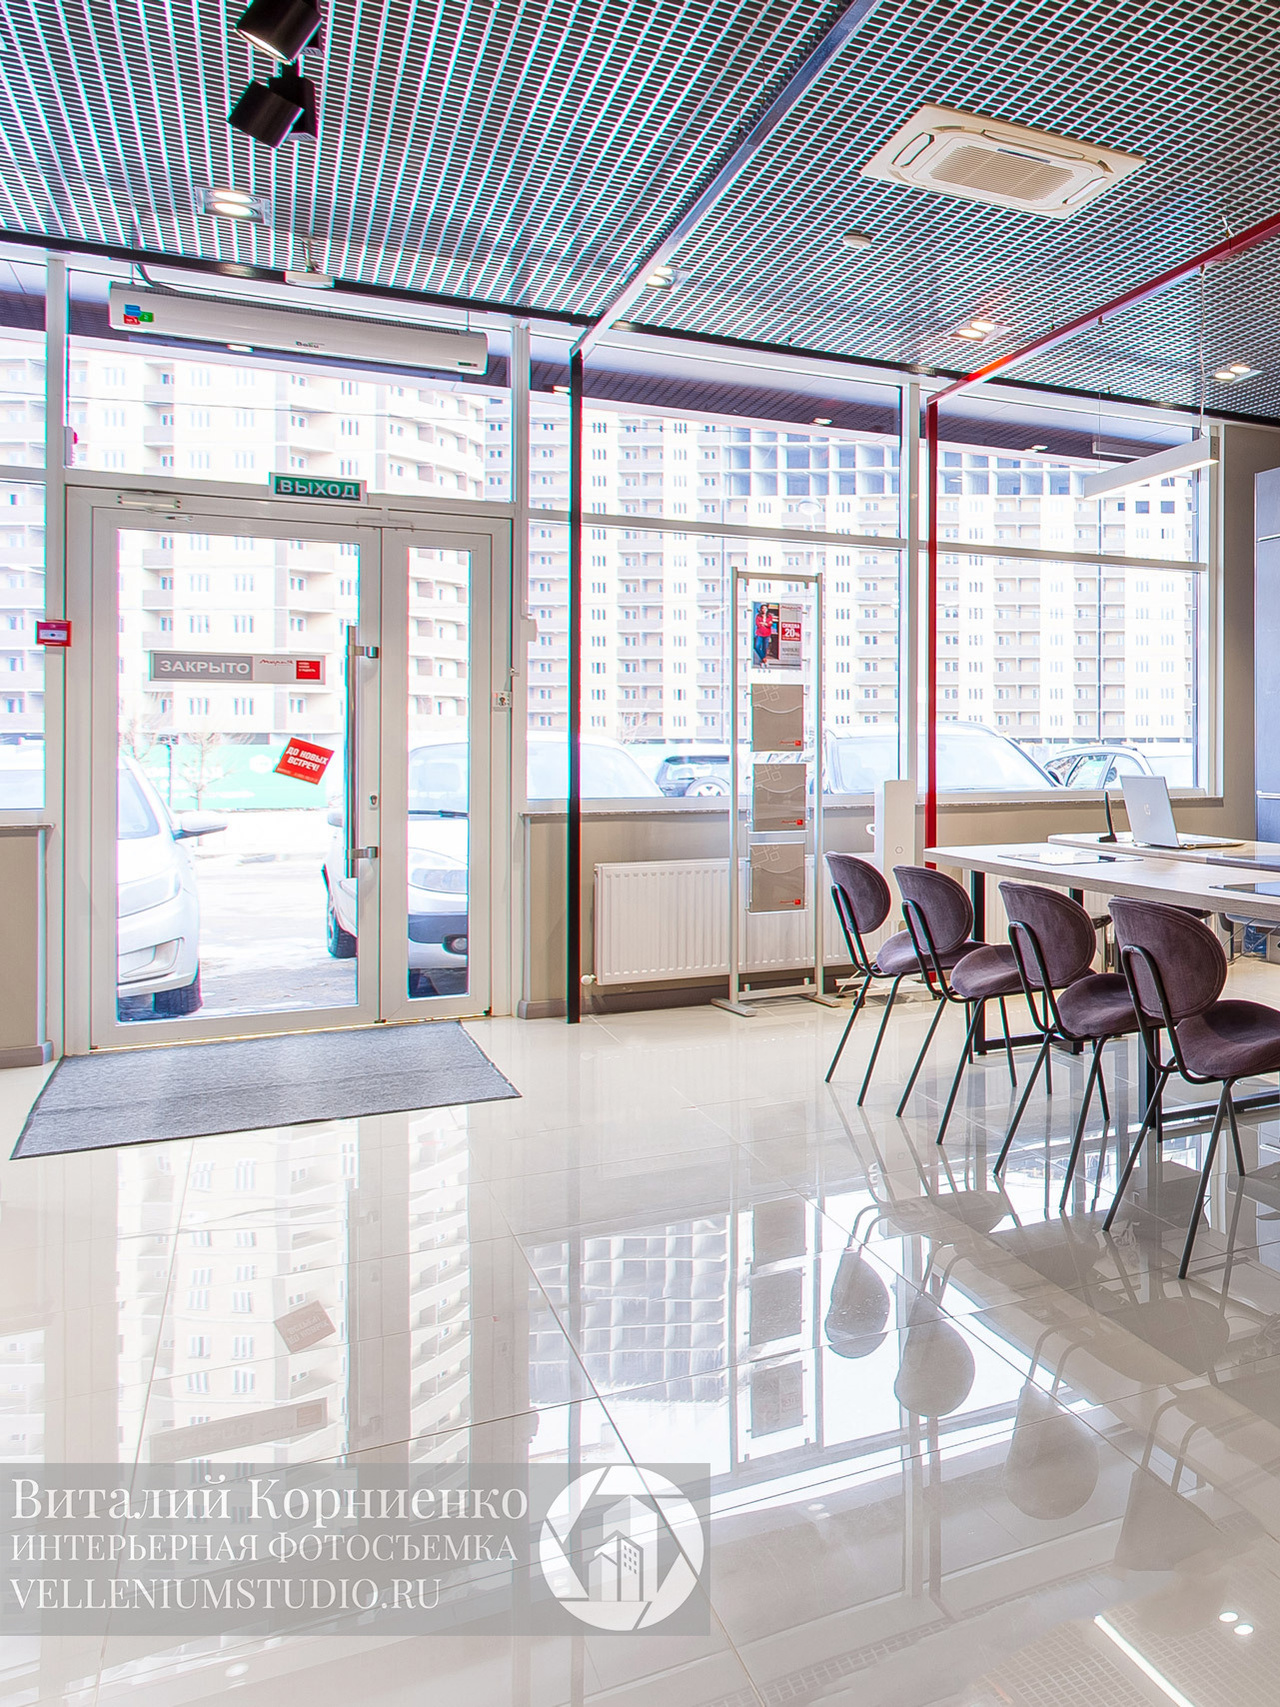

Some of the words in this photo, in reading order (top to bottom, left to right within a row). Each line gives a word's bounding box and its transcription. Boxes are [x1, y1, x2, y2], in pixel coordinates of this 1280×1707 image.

[280, 479, 360, 499] ВЫХОД
[160, 660, 250, 674] ЗАКРЫТО
[286, 746, 300, 756] ДО
[299, 750, 329, 765] НОВЫХ
[287, 756, 321, 772] ВСТРЕЧ!
